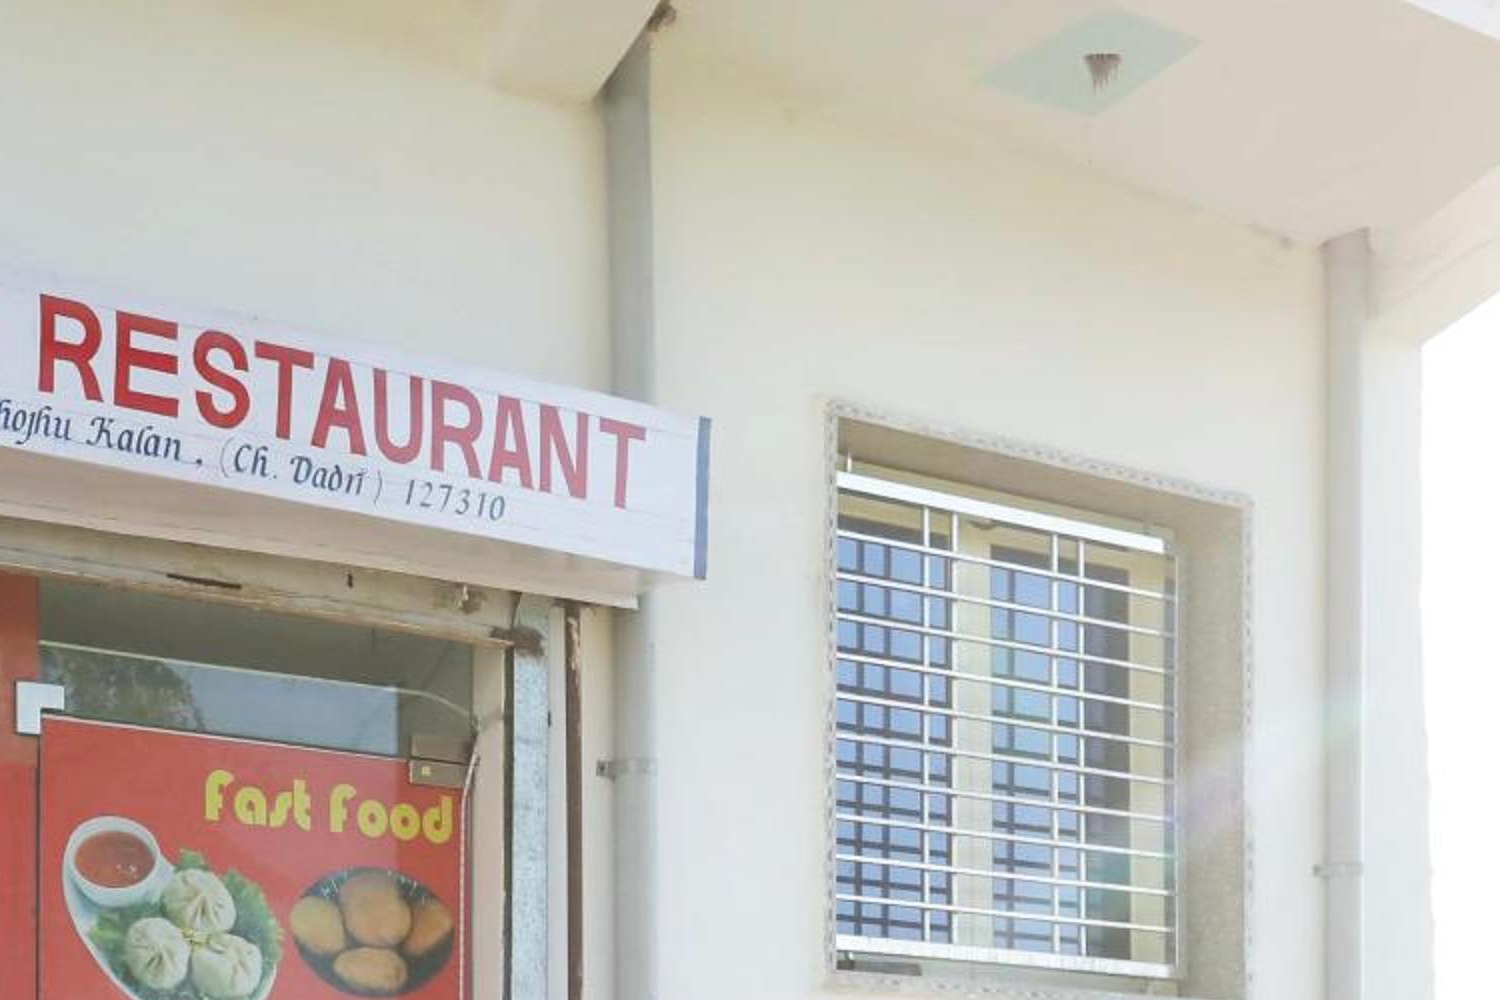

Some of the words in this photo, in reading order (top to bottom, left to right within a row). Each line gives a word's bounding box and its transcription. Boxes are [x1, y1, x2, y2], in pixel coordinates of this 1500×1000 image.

[38, 293, 647, 510] RESTAURANT
[404, 478, 506, 522] 127310
[205, 769, 312, 833] Fast
[329, 783, 453, 844] Food
